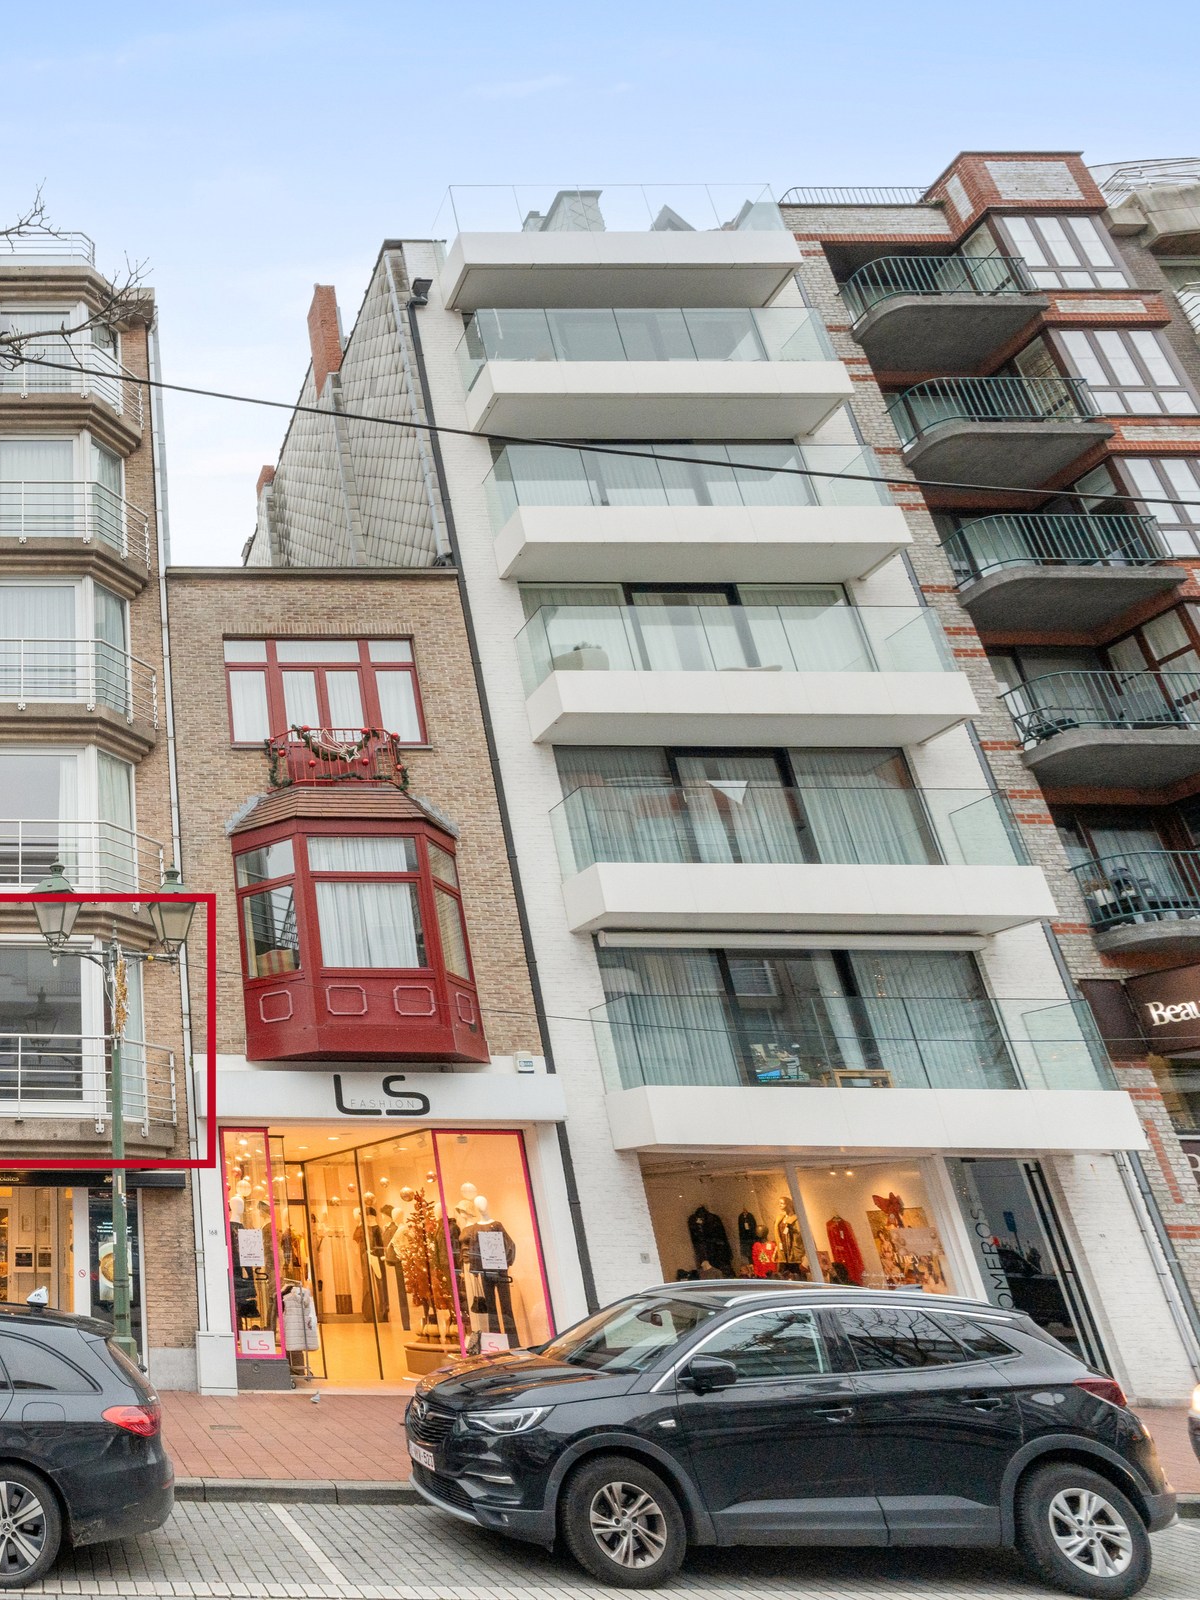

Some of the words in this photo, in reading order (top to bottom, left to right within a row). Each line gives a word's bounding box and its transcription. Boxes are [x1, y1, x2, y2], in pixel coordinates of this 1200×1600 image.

[333, 1073, 431, 1117] LS
[350, 1099, 415, 1109] FASHION
[247, 1339, 270, 1351] LS
